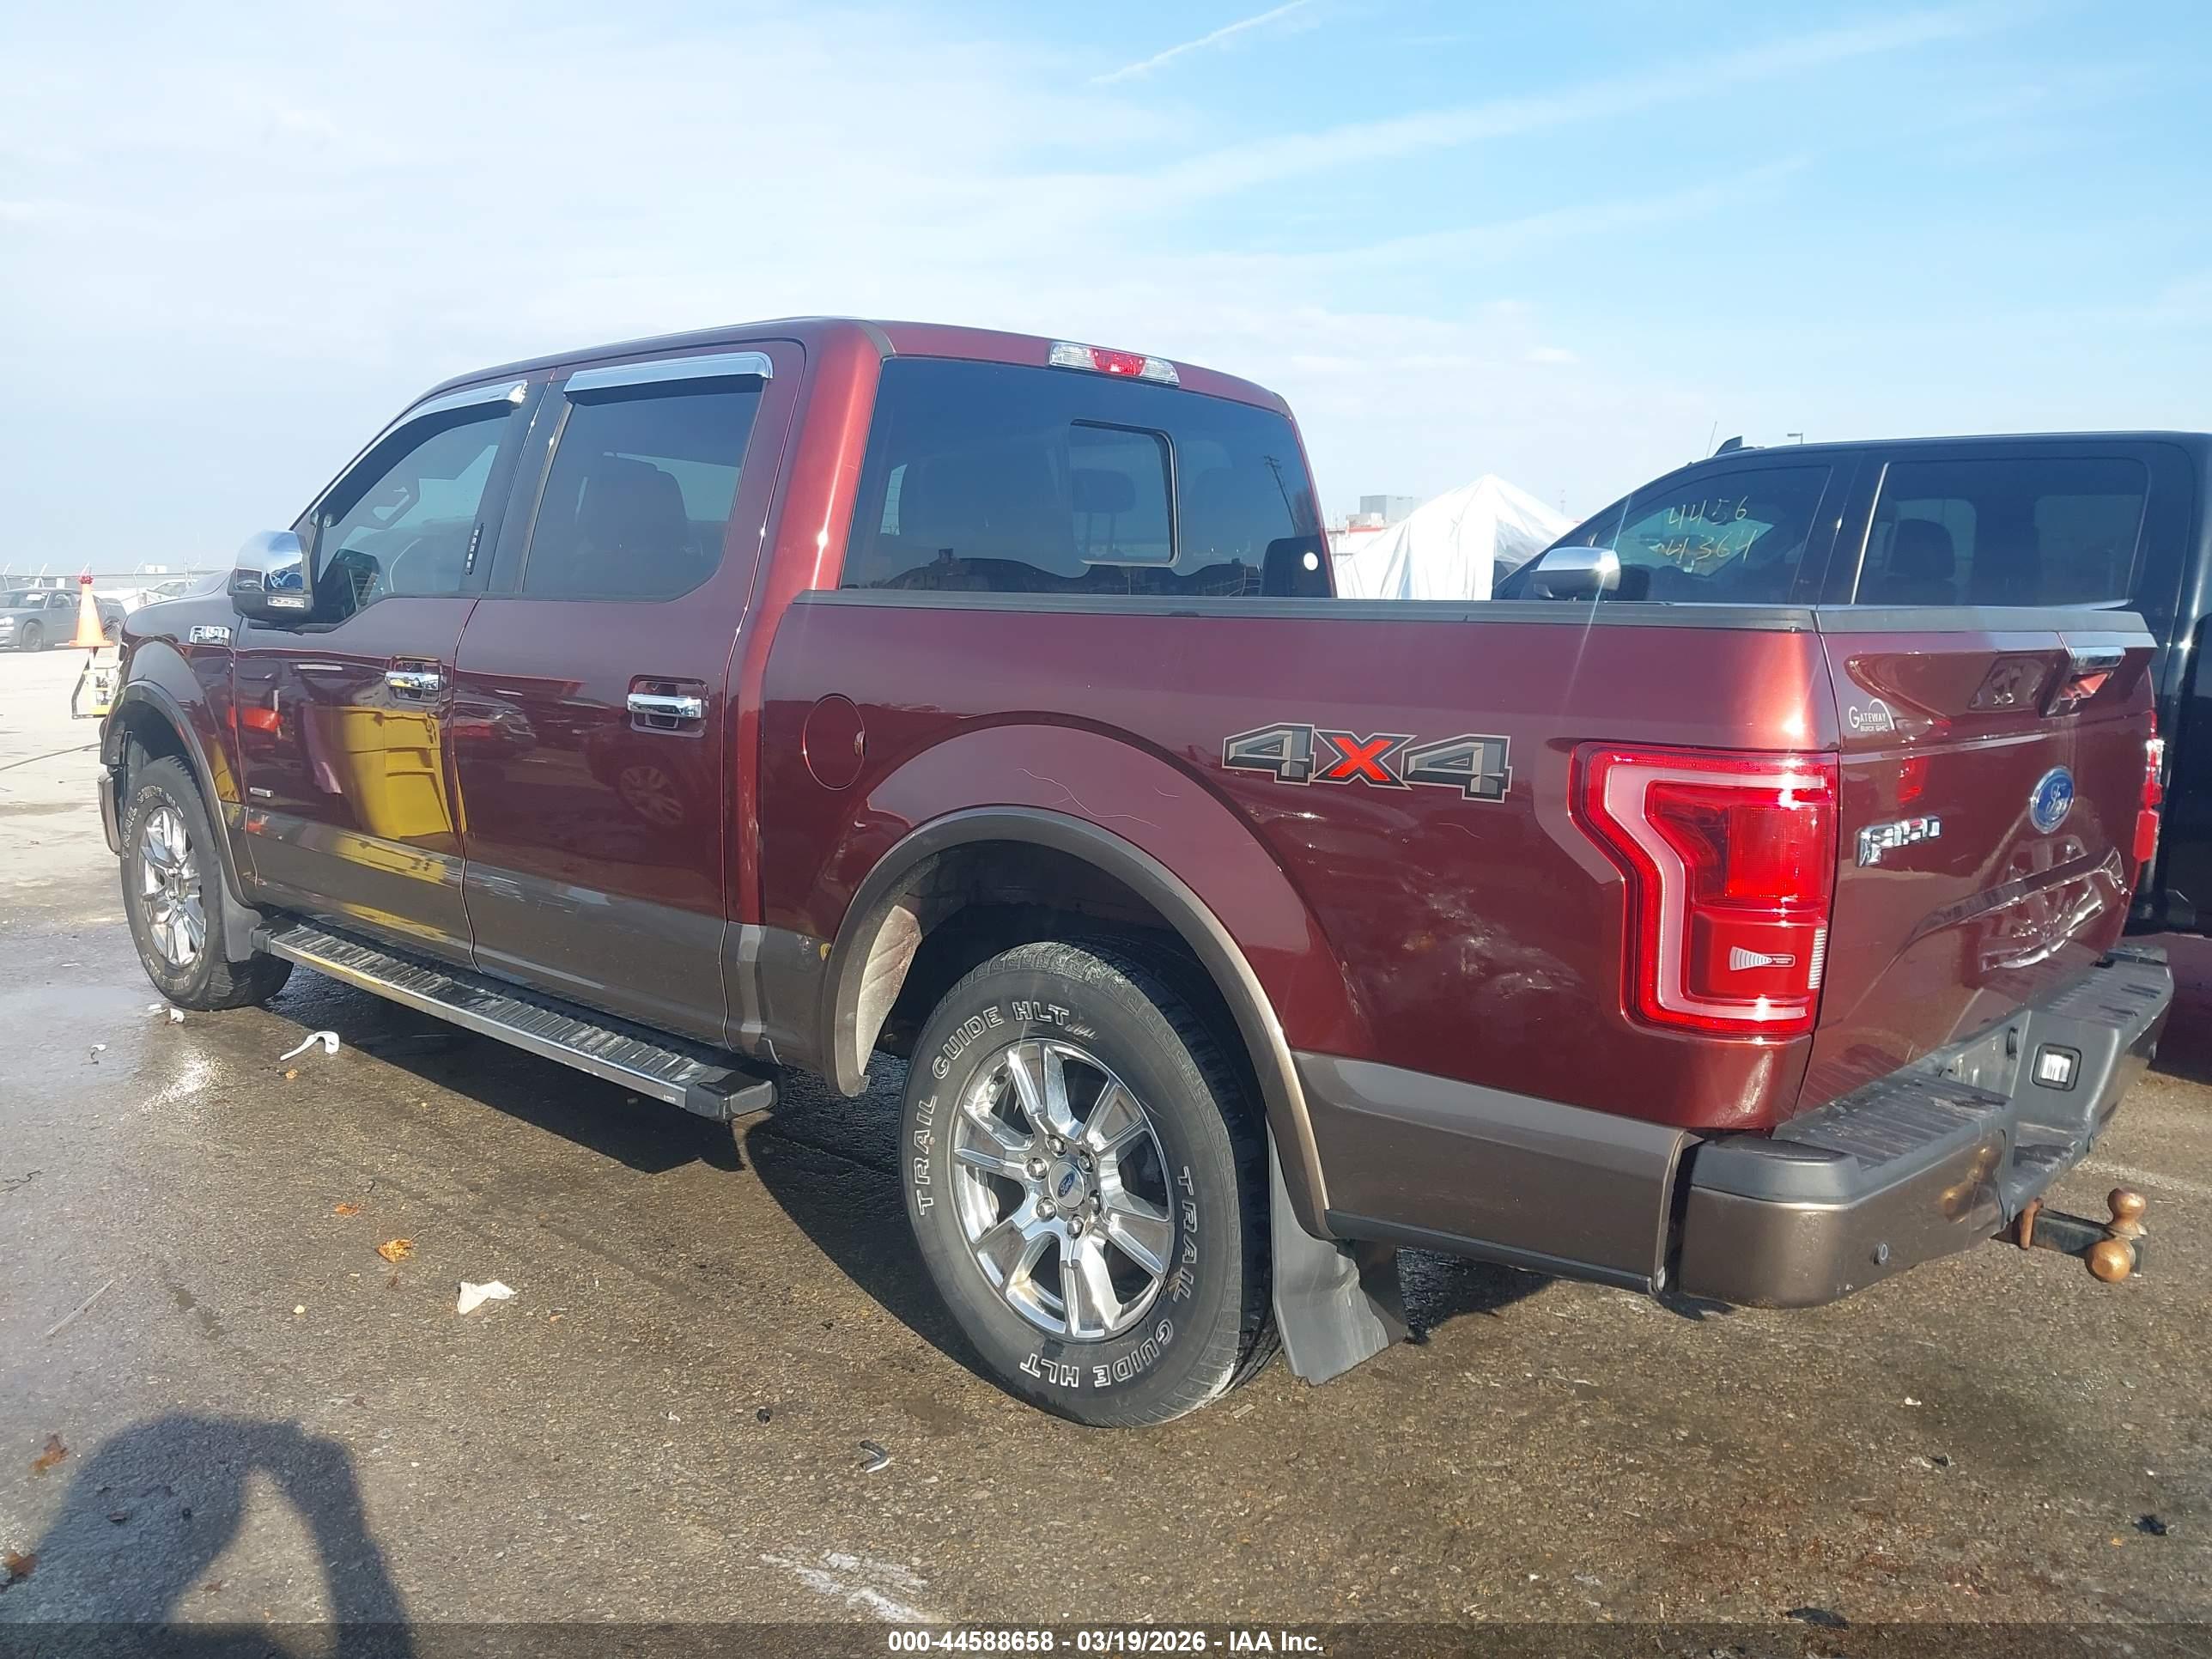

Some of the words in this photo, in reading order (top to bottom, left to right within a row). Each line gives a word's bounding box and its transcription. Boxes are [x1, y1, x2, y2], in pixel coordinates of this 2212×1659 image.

[1668, 495, 1748, 529] 4456
[1849, 705, 1887, 729] GATEWAY
[915, 1095, 938, 1216] TRAIL
[933, 1006, 1005, 1079] GUIDE
[1012, 1000, 1070, 1026] HLT
[1176, 1165, 1198, 1303] TRAIL
[1019, 1352, 1080, 1388] HLT
[1092, 1318, 1174, 1388] GUIDE
